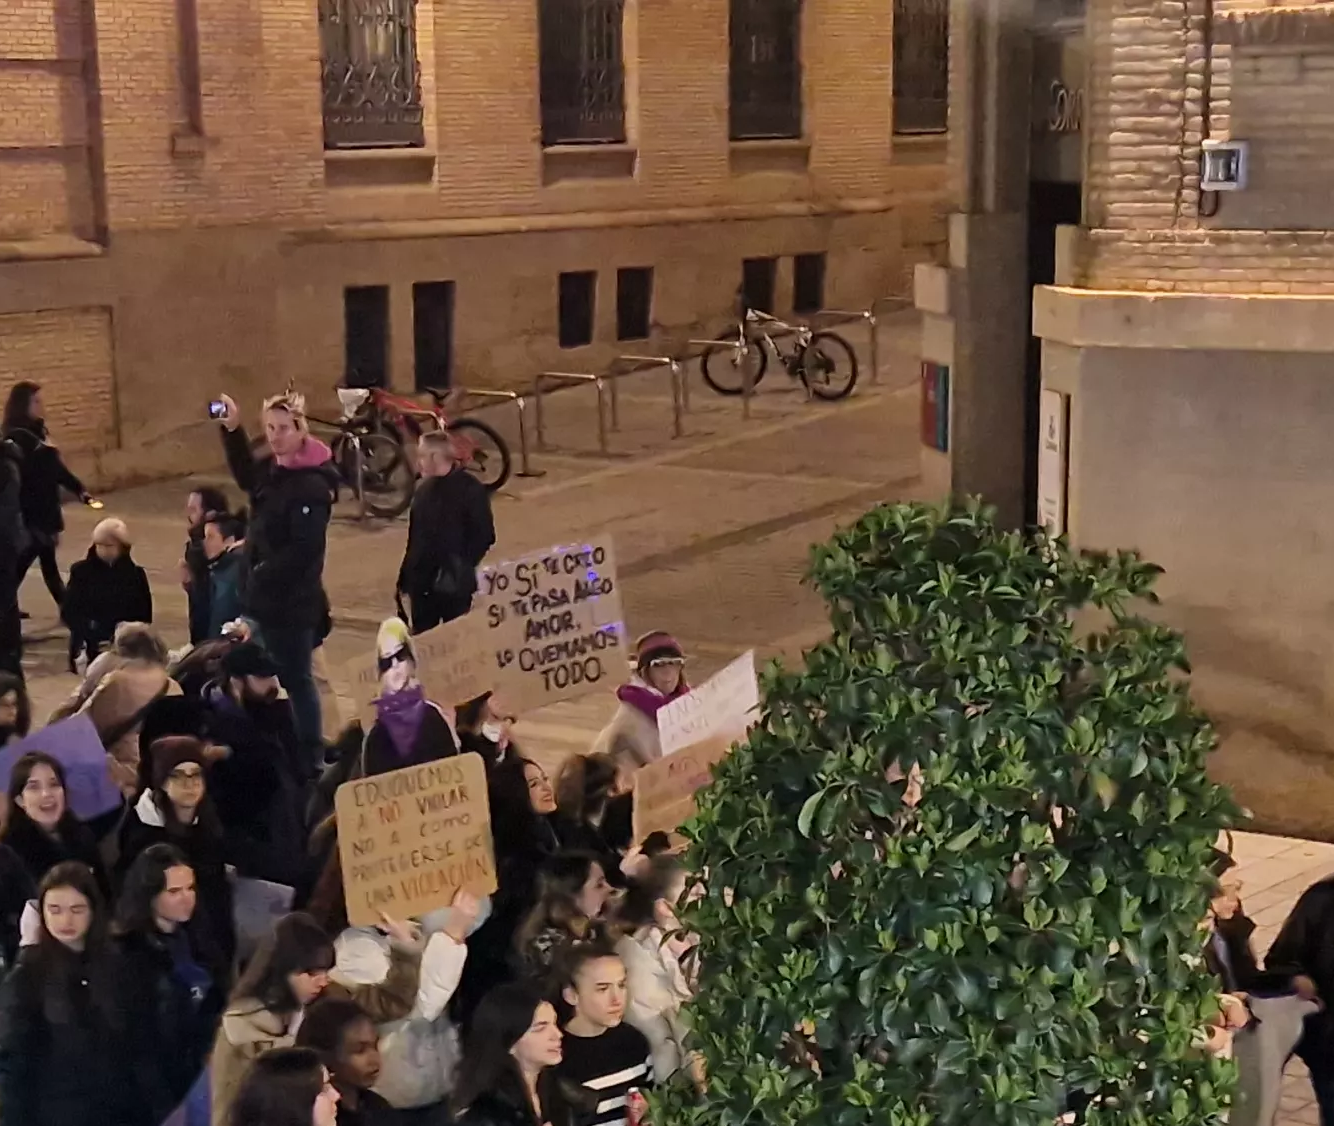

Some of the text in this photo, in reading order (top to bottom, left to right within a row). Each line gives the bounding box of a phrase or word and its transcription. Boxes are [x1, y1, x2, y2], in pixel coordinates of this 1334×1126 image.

[485, 572, 509, 596] YO
[541, 556, 560, 575] TE
[563, 546, 605, 574] CREO
[487, 577, 613, 628] SI TE PASA ALGO
[518, 625, 619, 672] QUEMAMOS
[378, 799, 402, 824] NO
